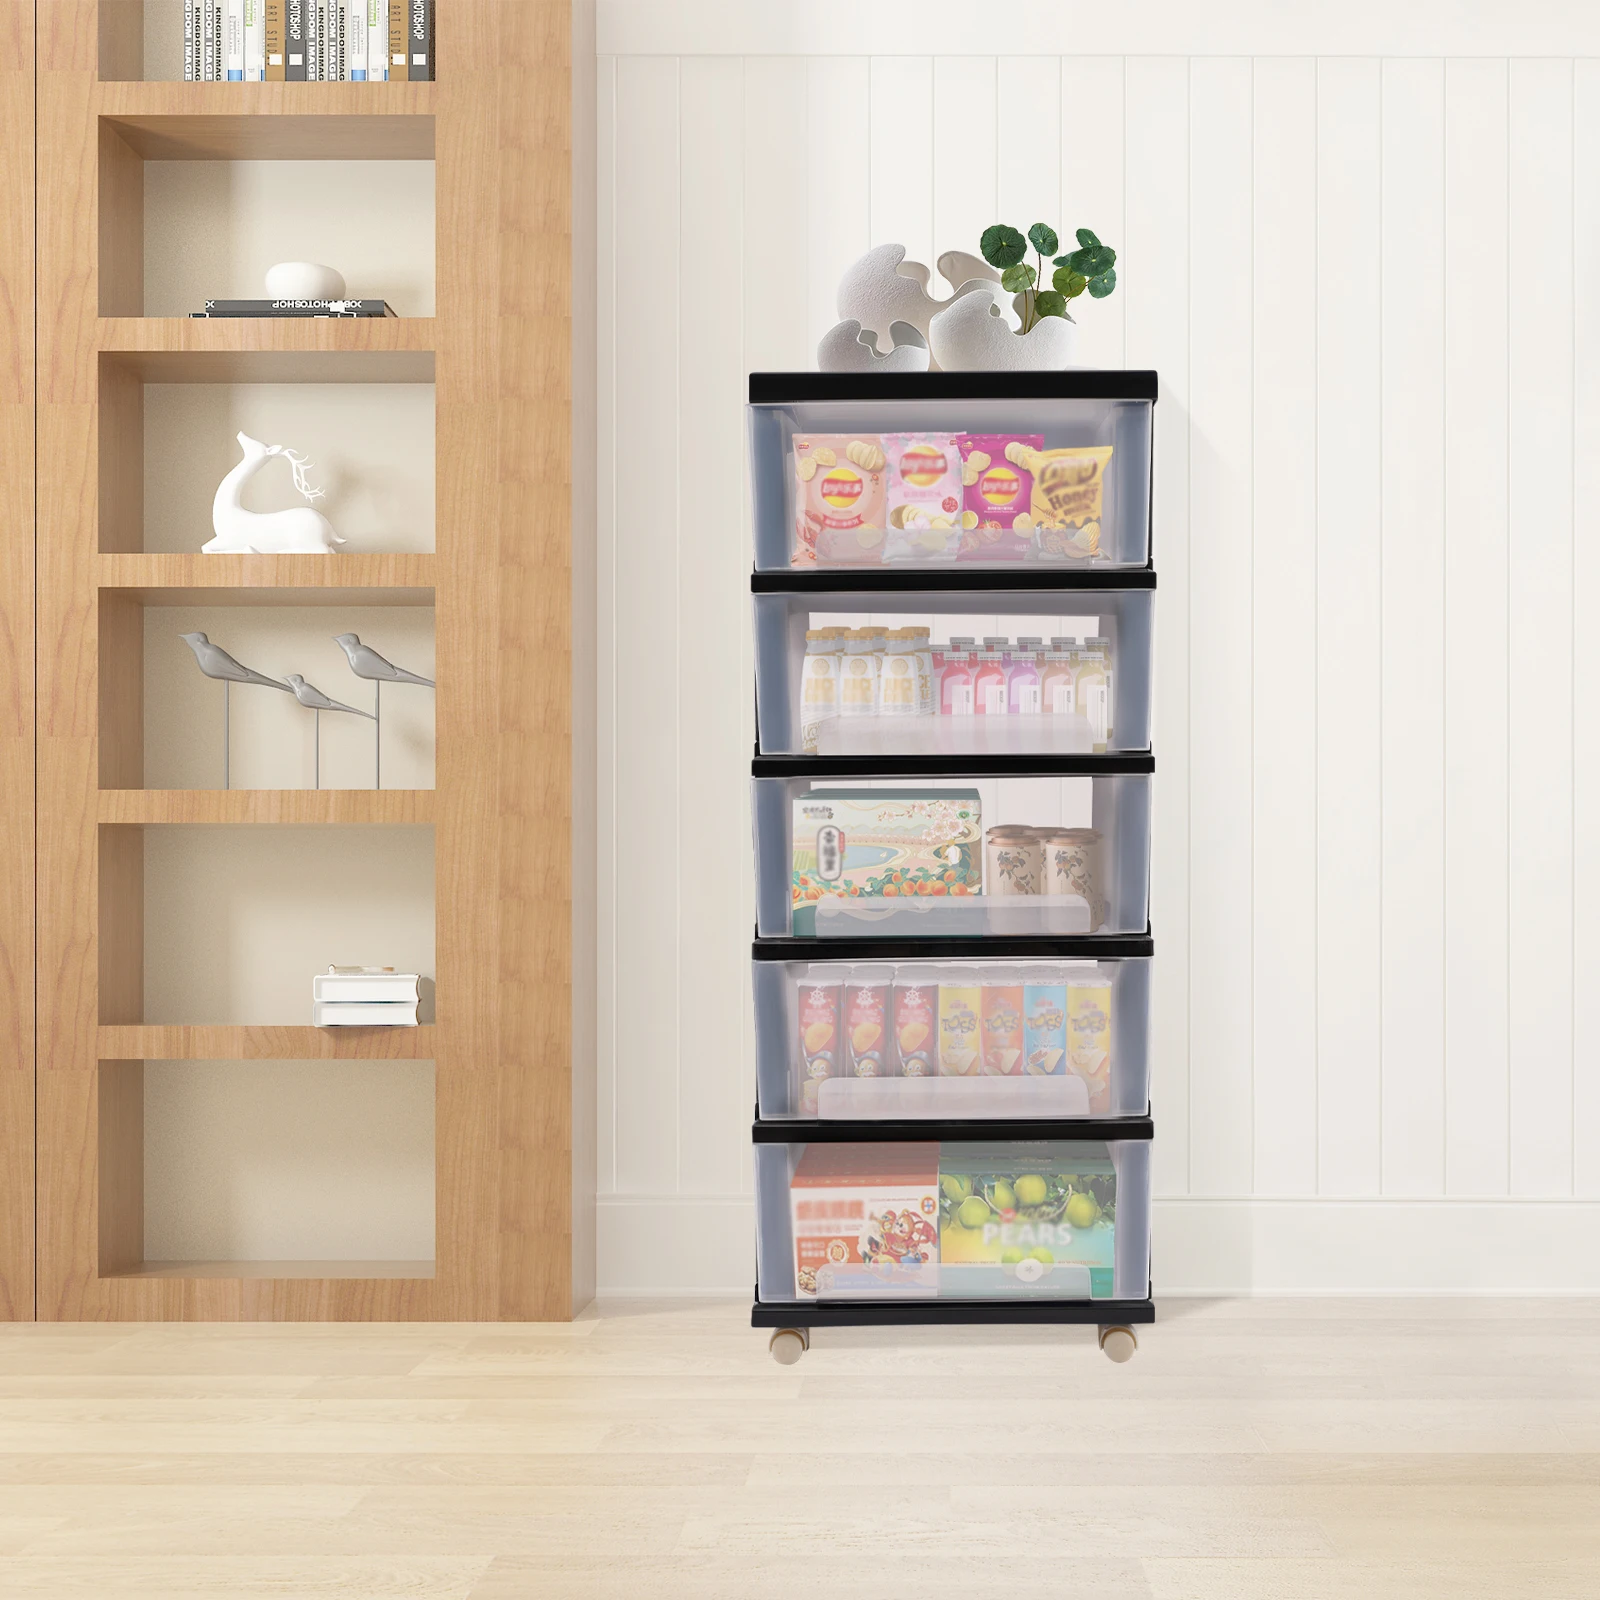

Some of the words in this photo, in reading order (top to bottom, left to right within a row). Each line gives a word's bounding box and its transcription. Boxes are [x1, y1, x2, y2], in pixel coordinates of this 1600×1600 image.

[268, 6, 277, 22] ART
[391, 5, 400, 22] ART
[1048, 488, 1098, 510] Honey
[982, 1222, 1072, 1246] PEARS
